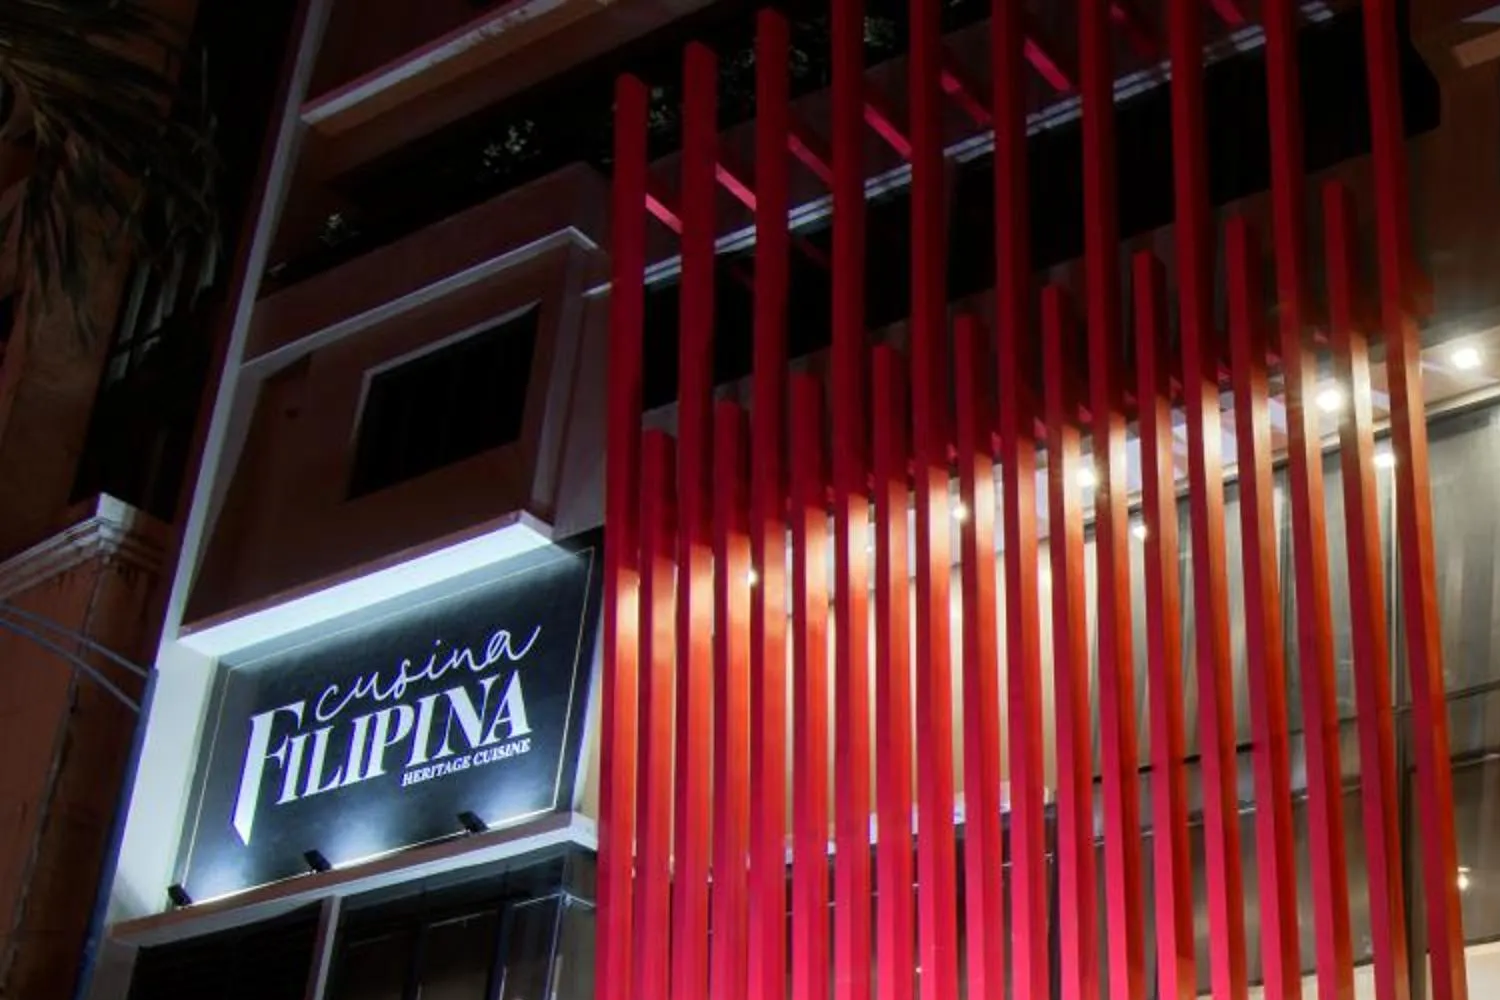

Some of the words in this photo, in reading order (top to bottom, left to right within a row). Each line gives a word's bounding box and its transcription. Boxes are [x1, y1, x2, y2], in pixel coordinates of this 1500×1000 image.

[314, 624, 542, 722] cusina
[231, 669, 532, 847] FILIPINA
[401, 756, 471, 786] HERITAGE
[473, 738, 531, 765] CUISINE
